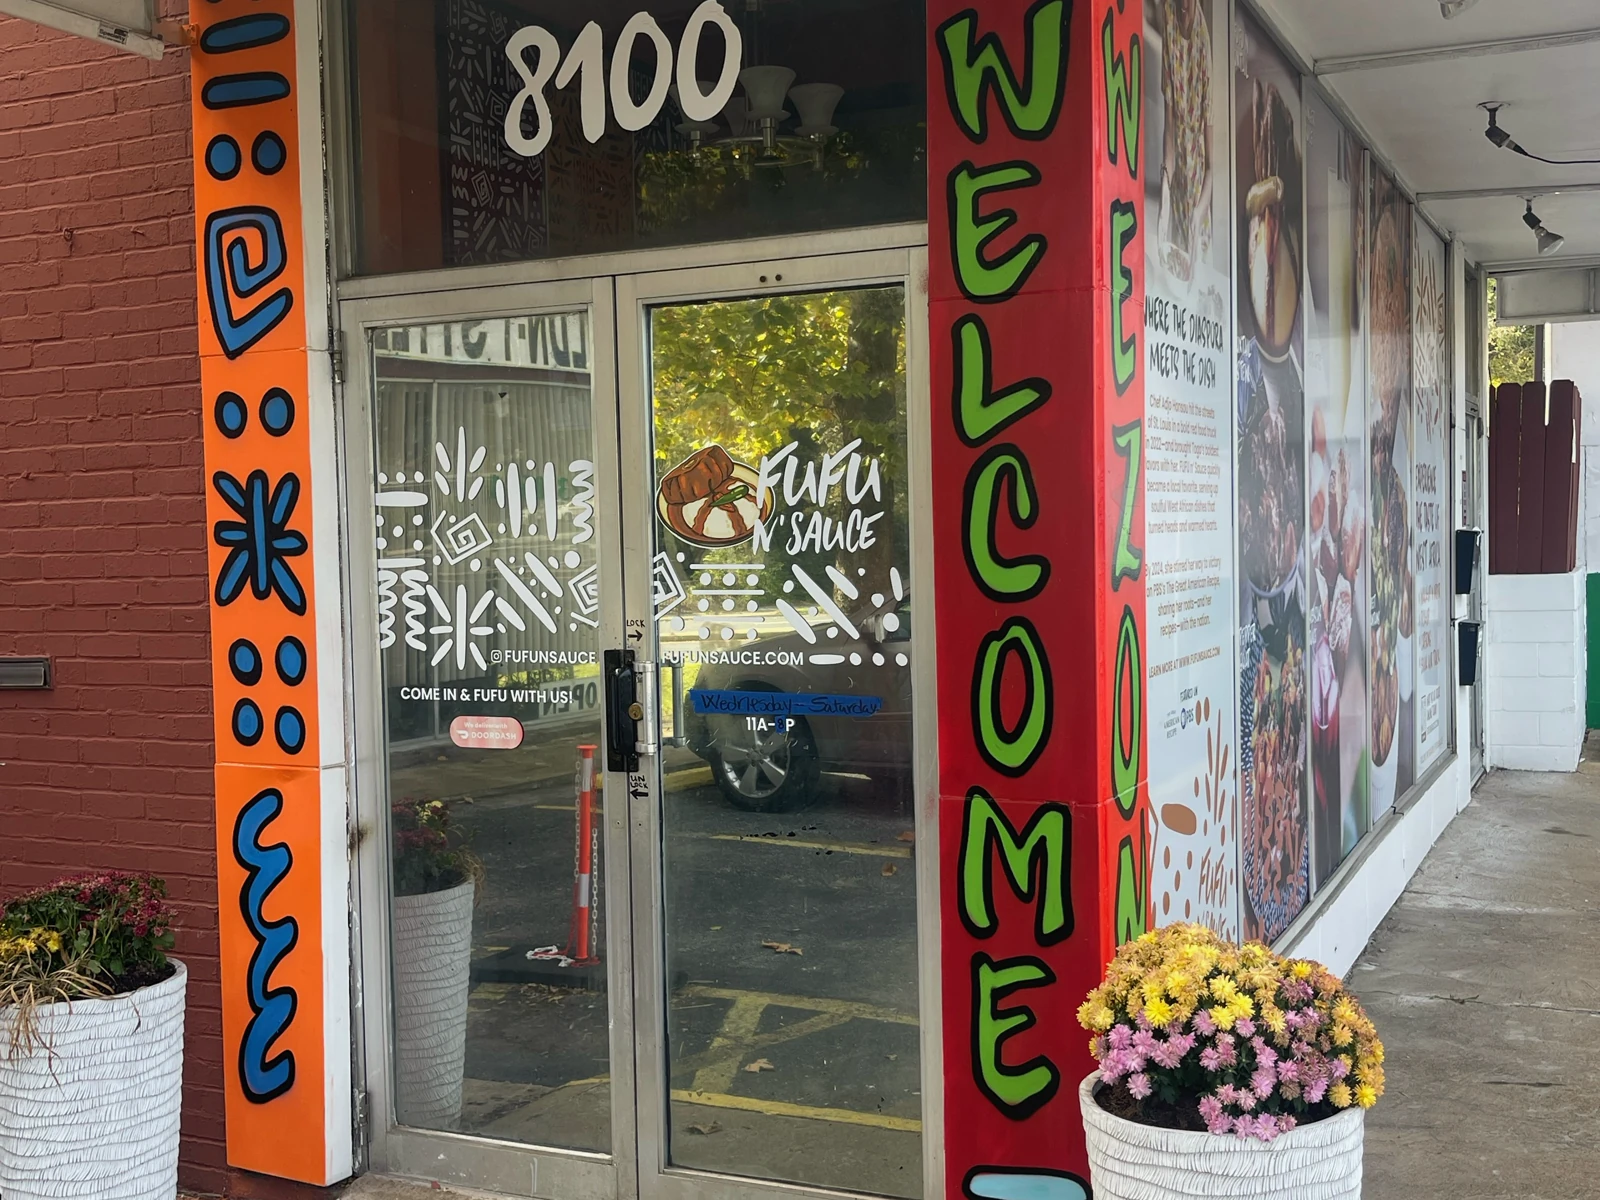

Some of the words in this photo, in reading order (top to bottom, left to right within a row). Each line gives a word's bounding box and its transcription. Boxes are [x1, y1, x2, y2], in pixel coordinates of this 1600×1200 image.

[504, 0, 742, 157] 8100
[1172, 304, 1186, 341] THE
[1189, 314, 1223, 353] DIASPORA
[1150, 342, 1179, 380] MEETS
[1182, 349, 1196, 385] THE
[1199, 357, 1216, 389] DISH
[1150, 394, 1161, 408] Chef
[1160, 417, 1171, 431] Louis
[756, 437, 862, 509] FUFU
[786, 508, 885, 556] SAUCE
[936, 0, 1075, 1120] WELCOME
[1166, 581, 1174, 594] The
[626, 619, 646, 628] LOCK
[661, 650, 804, 666] FUFUNSAUCE.COM
[1149, 664, 1161, 678] LEARN
[1162, 660, 1173, 674] MORE
[400, 687, 440, 701] COME
[443, 688, 456, 701] IN
[460, 689, 470, 702] &
[474, 688, 507, 702] FUFU
[511, 689, 547, 703] WITH
[550, 690, 573, 704] US!
[700, 693, 791, 715] Wednesday
[809, 696, 880, 715] Saturday
[471, 731, 517, 740] DOORDASH
[1199, 847, 1227, 909] FUFU
